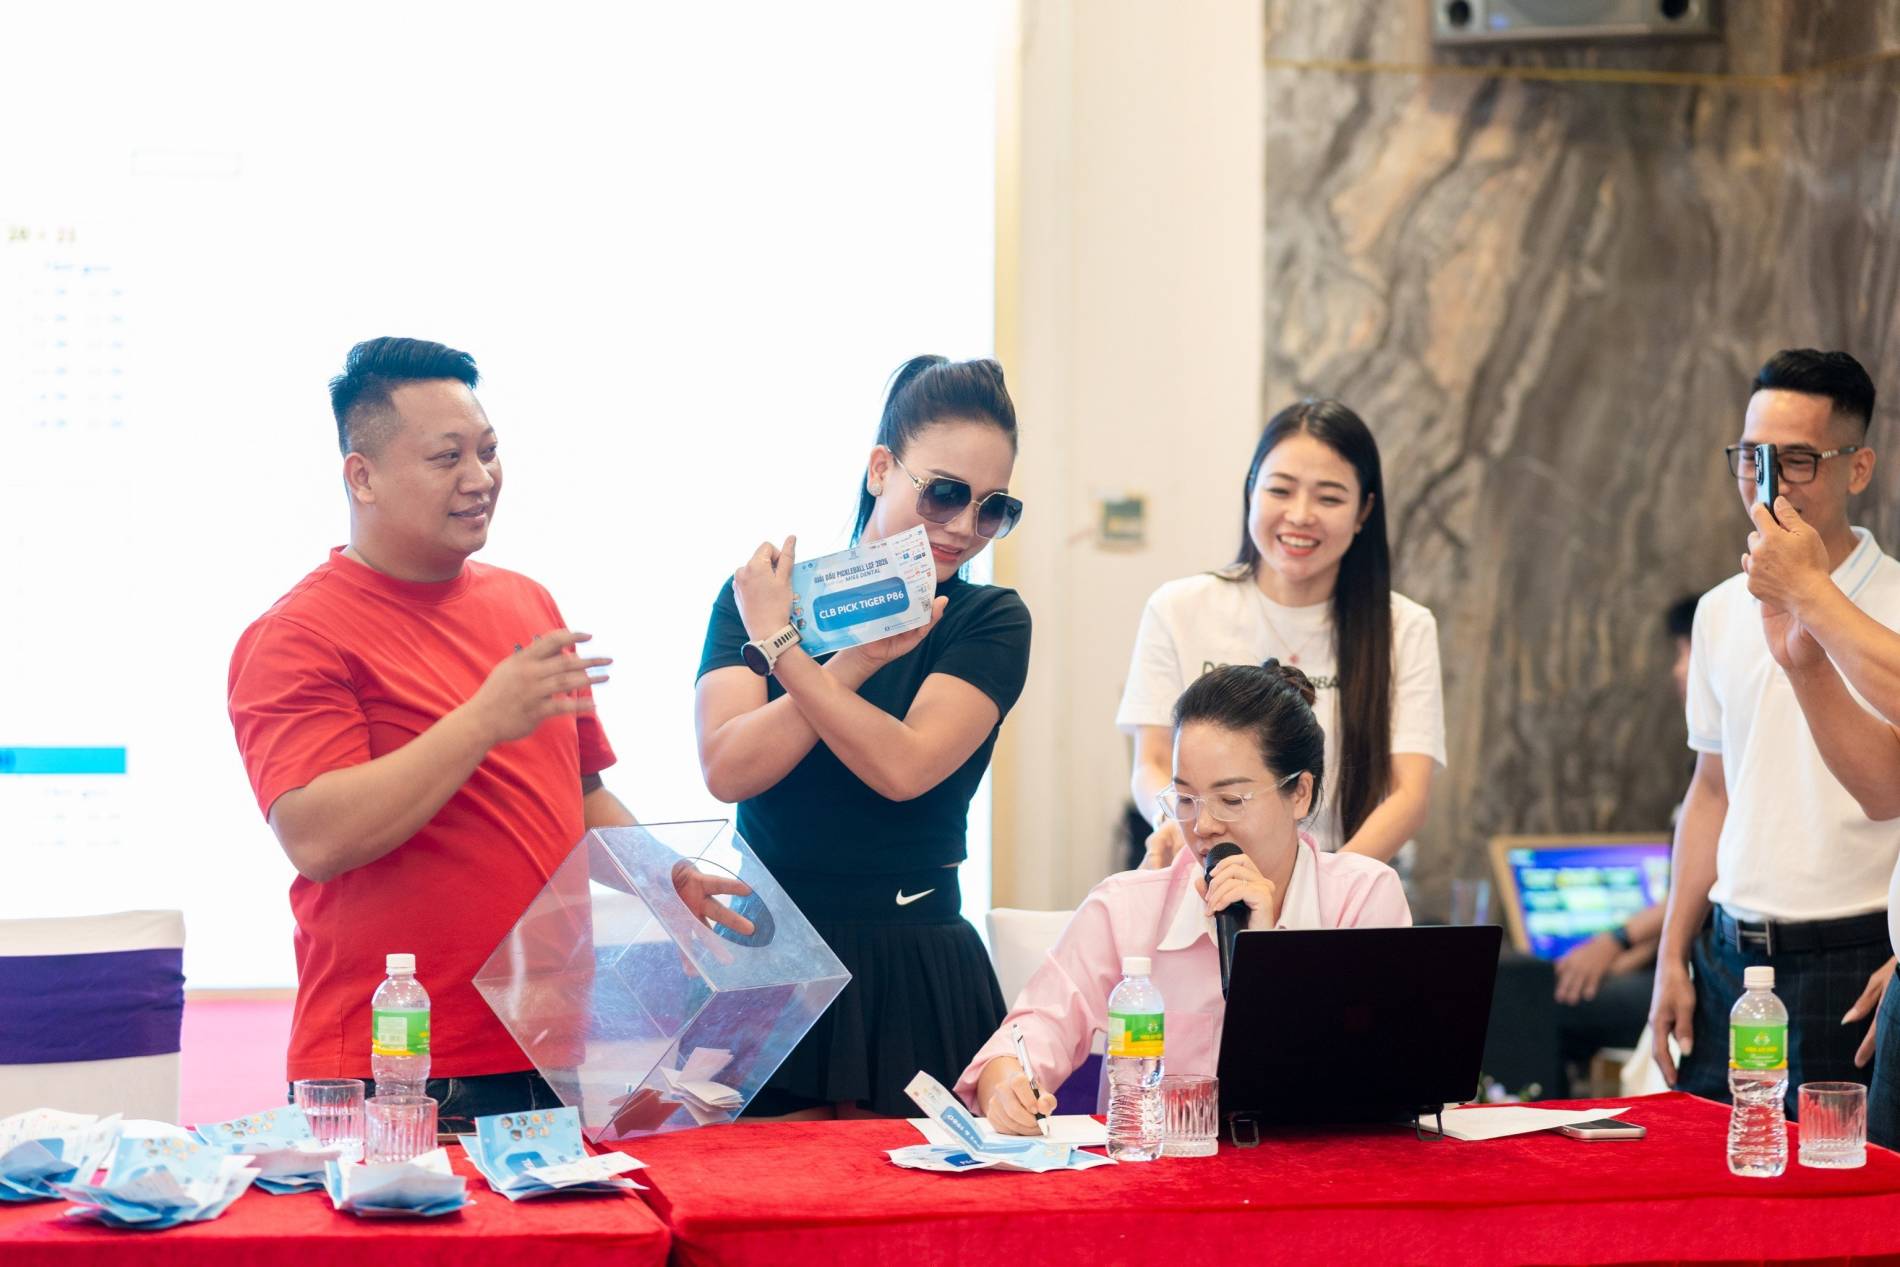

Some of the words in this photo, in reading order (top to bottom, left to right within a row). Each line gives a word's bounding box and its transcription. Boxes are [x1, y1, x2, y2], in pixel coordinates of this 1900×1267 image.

[819, 608, 837, 619] CLB
[837, 602, 859, 615] PICK
[859, 595, 886, 609] TIGER
